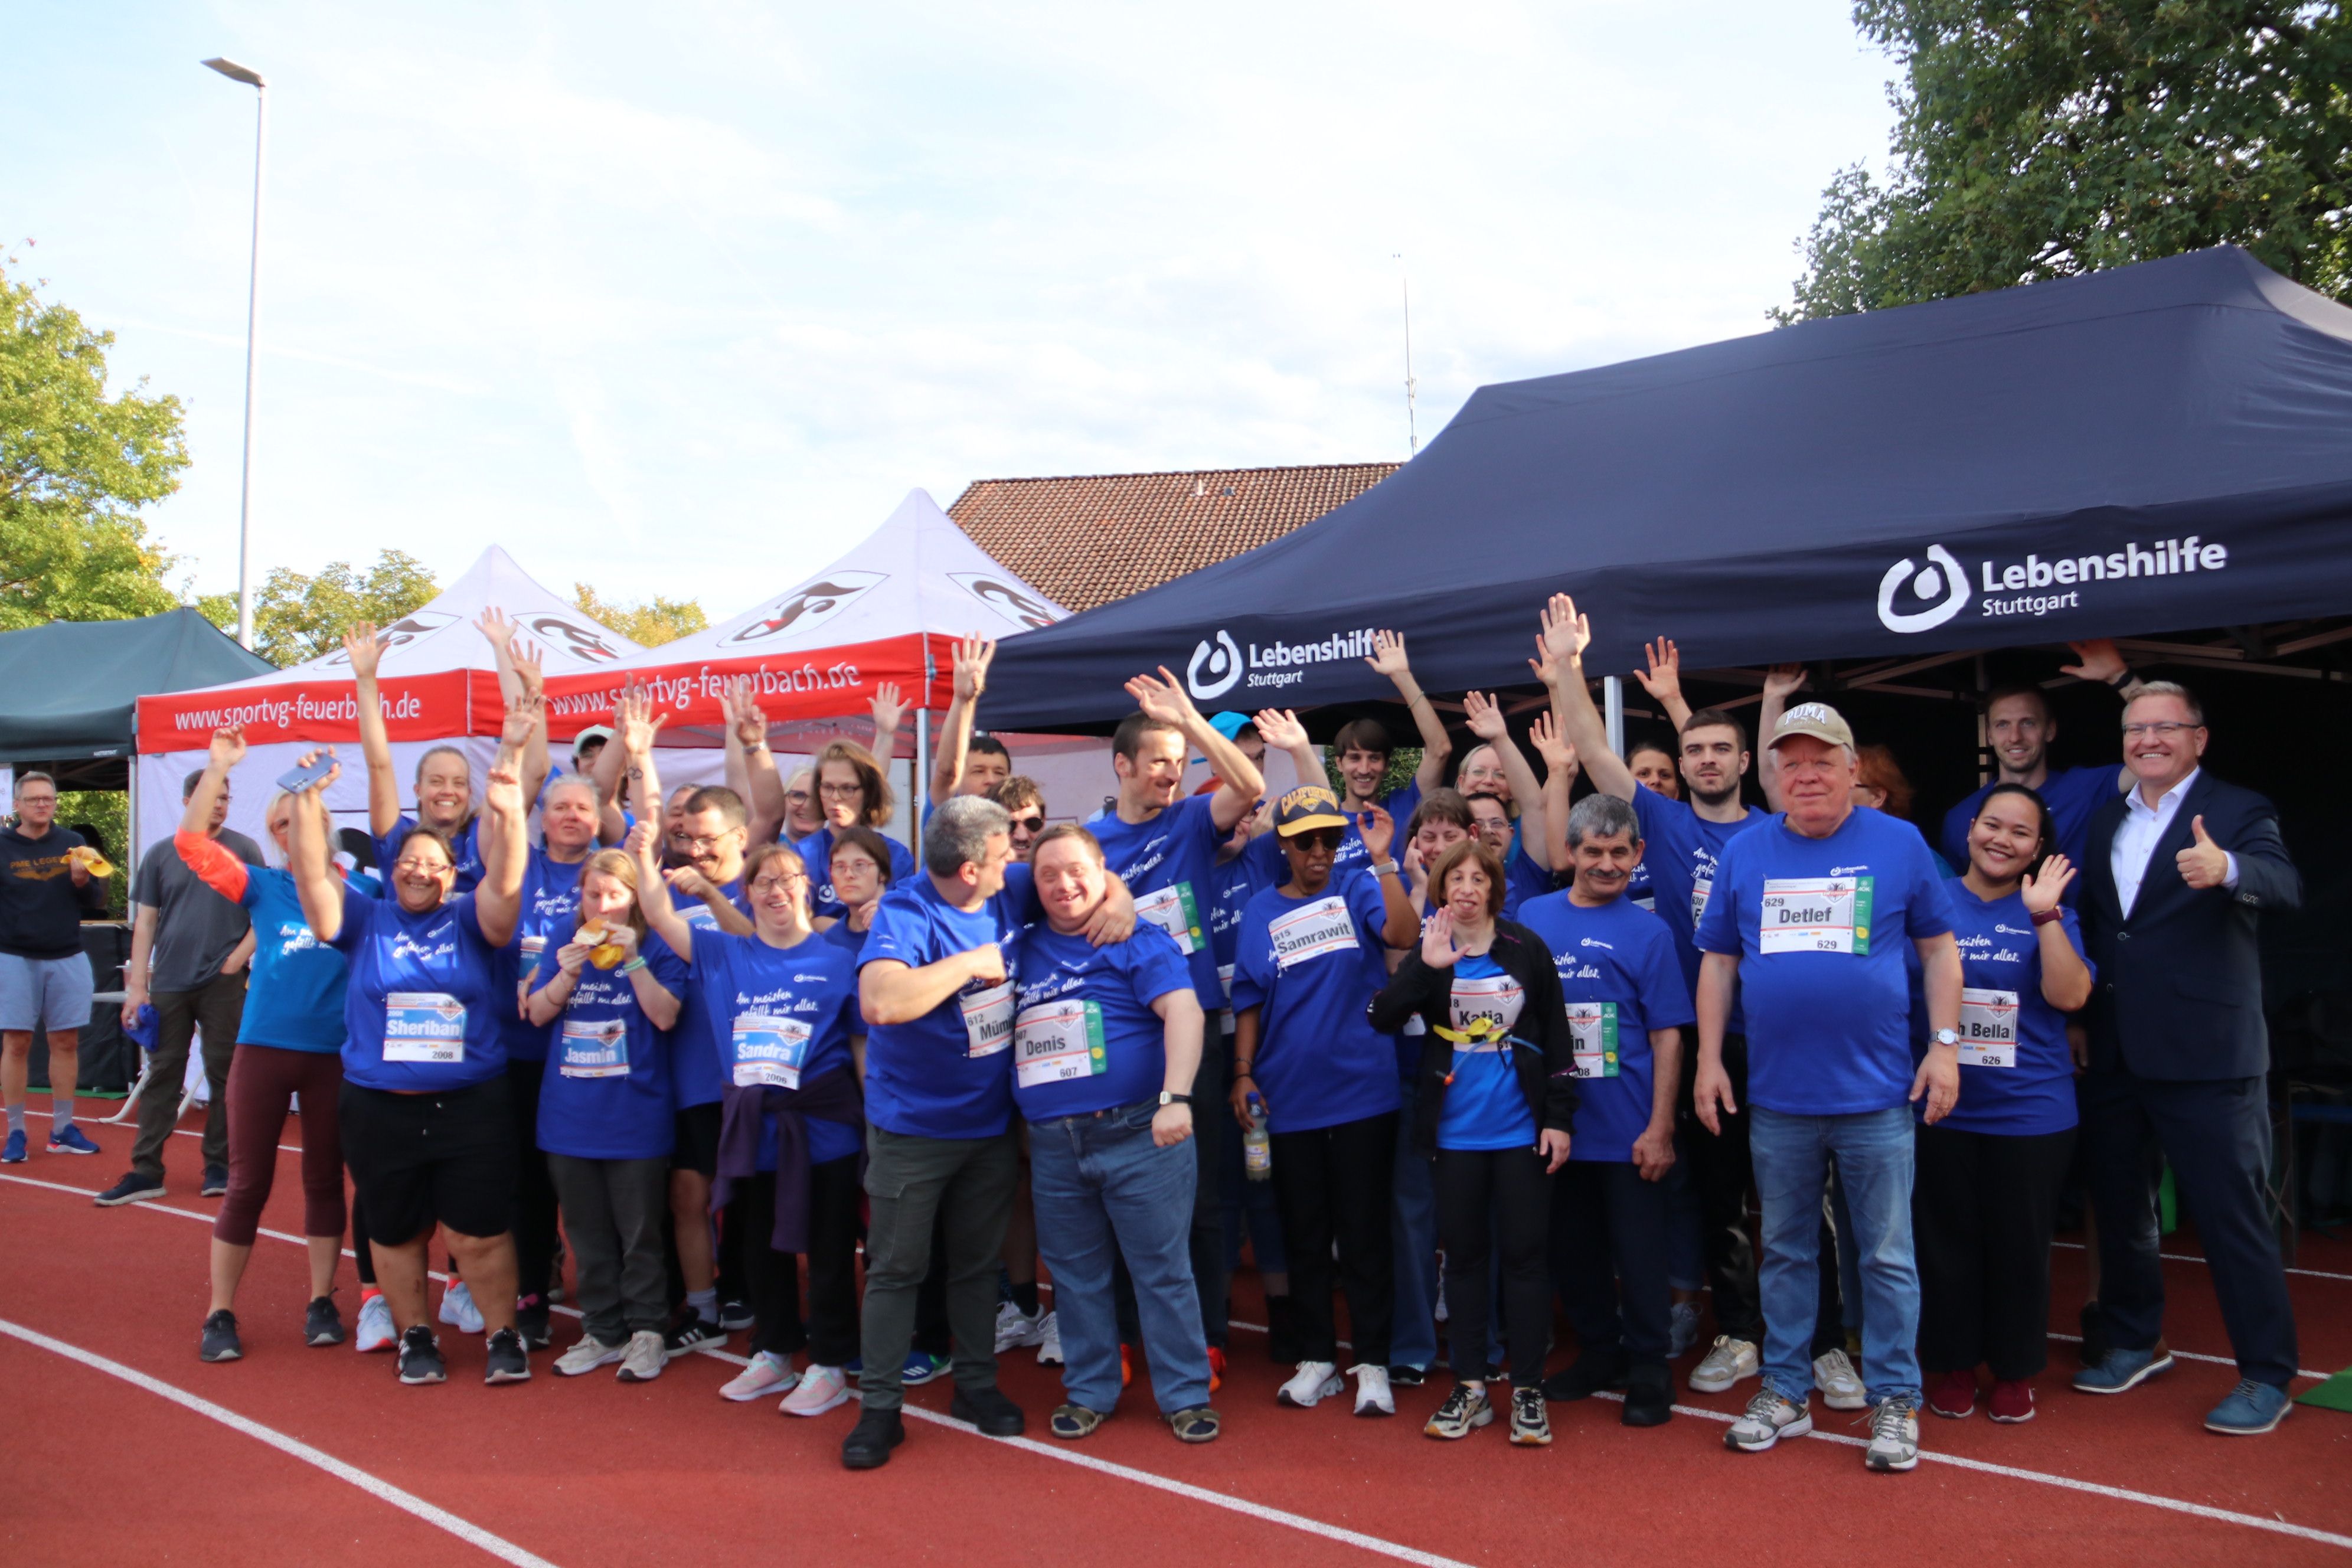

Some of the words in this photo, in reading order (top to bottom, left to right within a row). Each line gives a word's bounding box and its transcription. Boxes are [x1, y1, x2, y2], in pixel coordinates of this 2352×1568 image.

[1981, 535, 2227, 593] Lebenshilfe
[1982, 591, 2079, 617] Stuttgart
[1247, 669, 1303, 688] Stuttgart
[175, 691, 420, 730] www.sportvg-feuerbh.de
[1783, 704, 1826, 727] PUMA
[1281, 786, 1339, 817] CALIFORNIA
[1691, 896, 1704, 906] 630
[1765, 898, 1784, 907] 629
[1779, 907, 1832, 924] Detlef
[1273, 929, 1291, 942] 615
[1277, 922, 1351, 954] Samrawit
[1817, 940, 1837, 949] 629
[1969, 950, 1990, 961] mir
[736, 992, 750, 1005] Am
[753, 988, 793, 1004] meisten
[773, 1004, 792, 1015] mir
[387, 1019, 460, 1036] Sheriban
[967, 1014, 984, 1026] 612
[1971, 1023, 2010, 1038] Bella
[737, 1042, 792, 1061] Sandra
[1025, 1035, 1066, 1057] Denis
[432, 1051, 454, 1060] 2008
[564, 1047, 617, 1064] Jasmin
[1982, 1056, 2001, 1066] 626
[765, 1072, 788, 1085] 2006
[1059, 1067, 1077, 1078] 607
